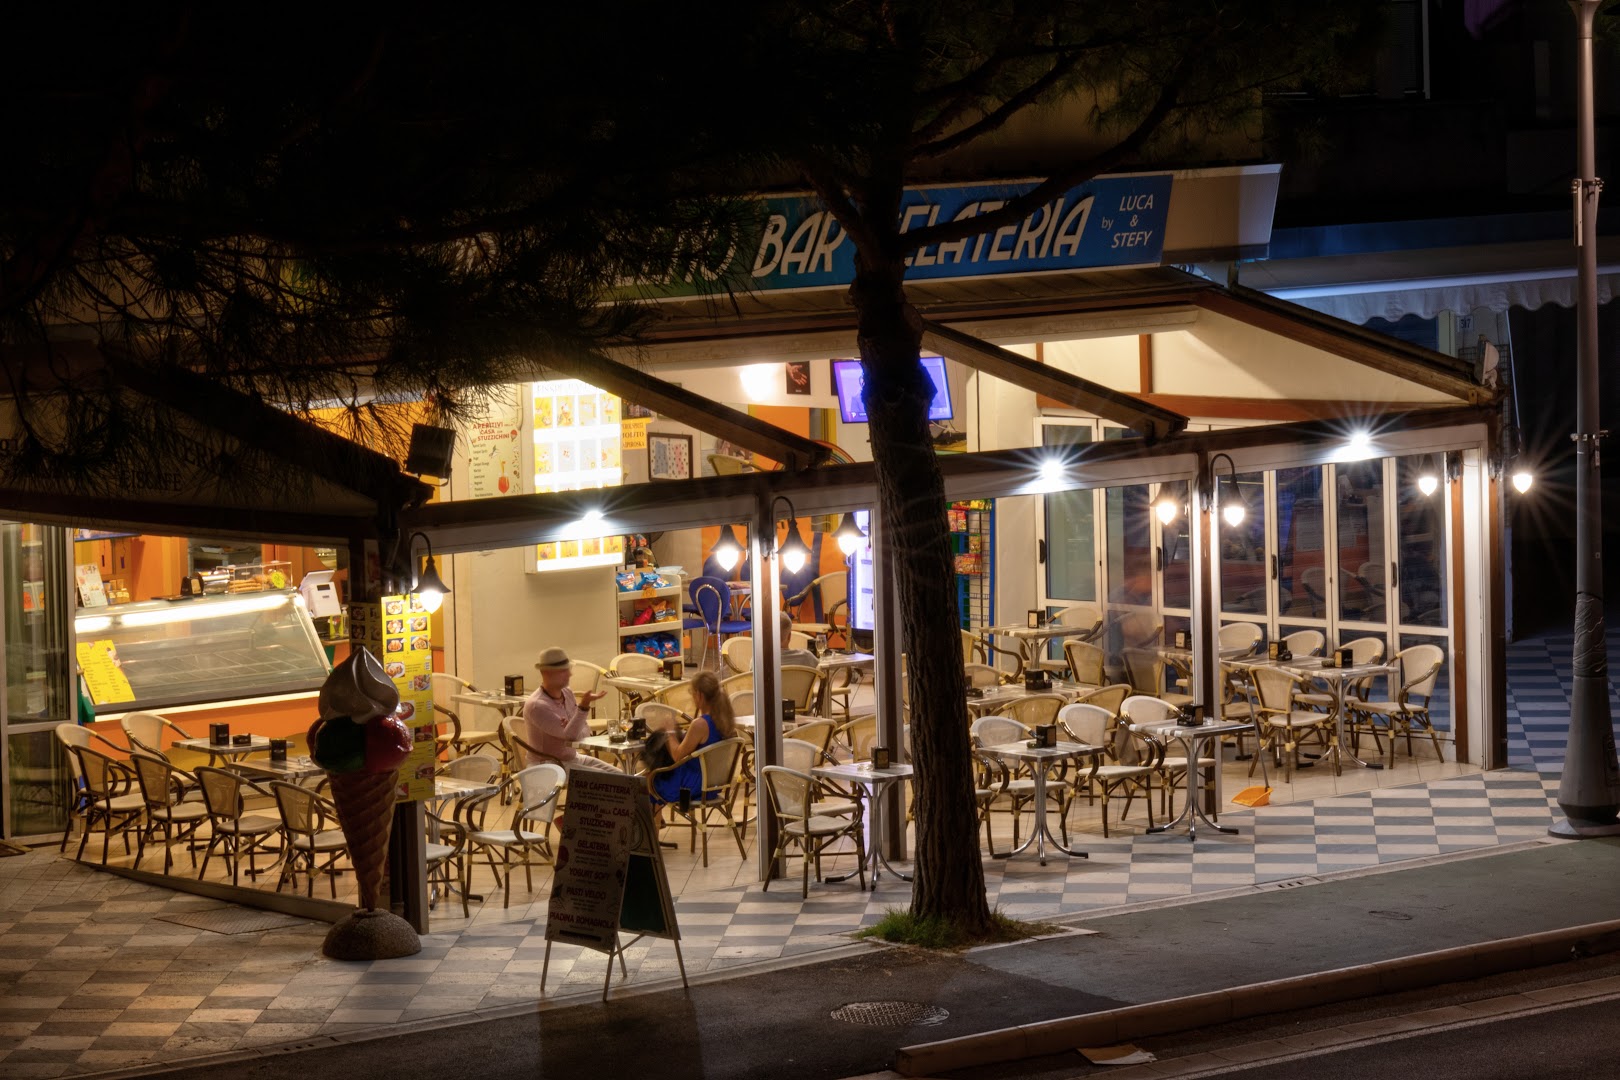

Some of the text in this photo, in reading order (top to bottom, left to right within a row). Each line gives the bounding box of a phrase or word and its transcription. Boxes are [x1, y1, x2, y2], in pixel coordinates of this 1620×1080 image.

[1119, 194, 1154, 212] LUCA
[1101, 216, 1114, 231] by
[1129, 214, 1139, 228] &
[751, 210, 848, 277] BAR
[896, 196, 1096, 267] ELATERIA
[1111, 230, 1154, 249] STEFY
[472, 421, 504, 430] APERITIVI
[477, 433, 510, 442] STUZZICHINI
[574, 780, 631, 796] BAR CAFFETTERIA
[569, 801, 599, 813] APERITIVI
[613, 807, 630, 817] CASA
[579, 816, 616, 829] STUZZICHINI
[577, 839, 610, 852] GELATERIA
[569, 866, 593, 879] YOGURT
[566, 886, 583, 897] PASTI
[549, 911, 575, 923] PIADINA
[575, 915, 615, 929] ROMAGNOLA
